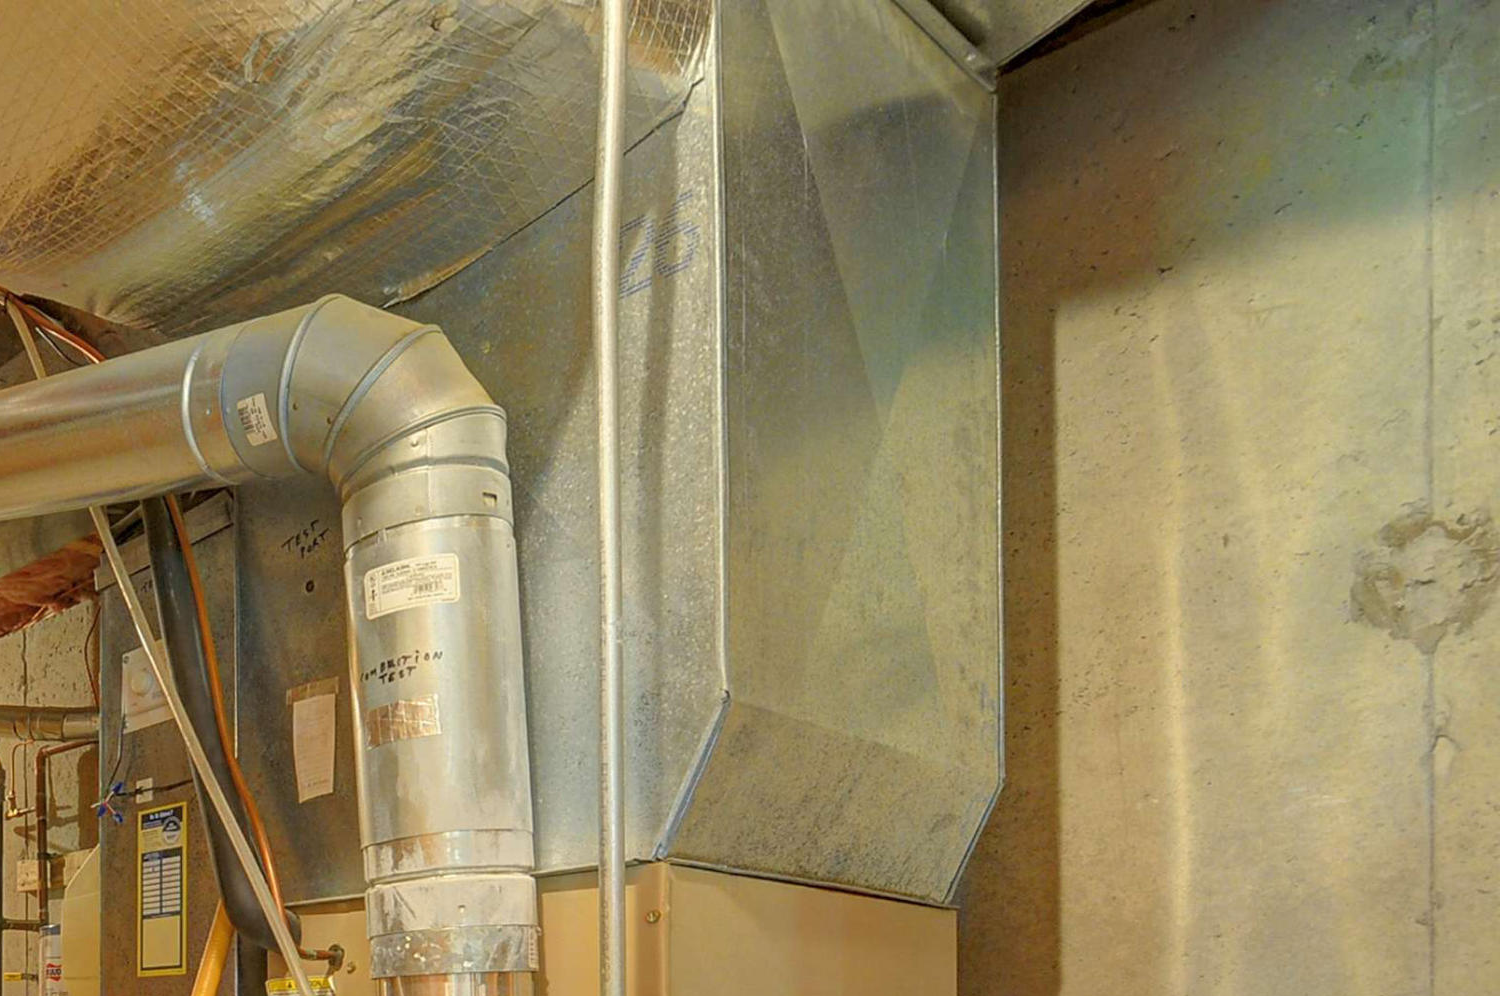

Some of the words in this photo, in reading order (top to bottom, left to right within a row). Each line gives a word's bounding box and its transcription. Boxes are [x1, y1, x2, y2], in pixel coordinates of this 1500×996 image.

[281, 519, 320, 552] TEST
[301, 528, 330, 559] PORT
[378, 666, 417, 684] TEST
